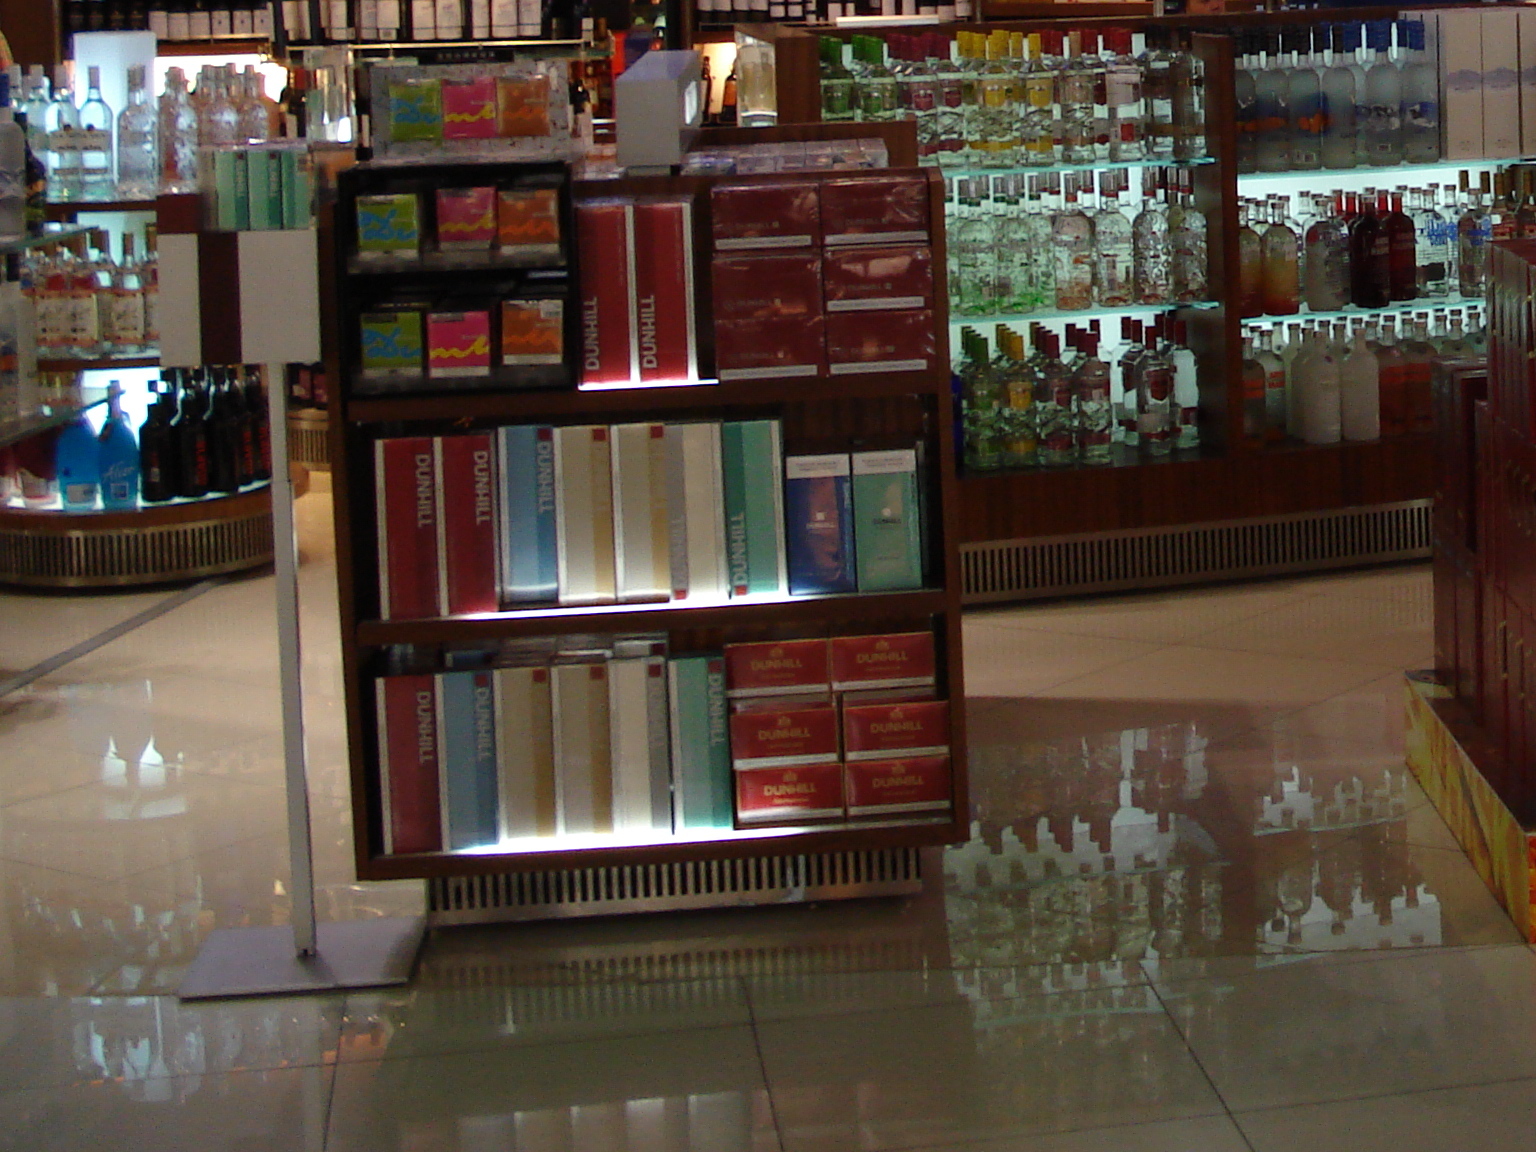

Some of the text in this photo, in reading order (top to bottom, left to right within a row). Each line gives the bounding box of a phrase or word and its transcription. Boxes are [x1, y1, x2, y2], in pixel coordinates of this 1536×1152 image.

[584, 296, 599, 371] DUNHILL
[641, 295, 657, 369] DUNHILL
[415, 453, 434, 529] DUNHILL
[472, 451, 491, 526] DUNHILL
[536, 443, 553, 515] DUNHILL
[731, 512, 748, 588] DUNHILL
[856, 651, 908, 663] DUNHILL
[416, 691, 434, 764] DUNHILL
[475, 687, 493, 761] DUNHILL
[707, 673, 726, 747] DUNHILL
[758, 728, 810, 740] DUNHILL
[870, 721, 923, 733] DUNHILL
[763, 782, 817, 796] DUNHILL
[872, 775, 924, 788] DUNHILL
